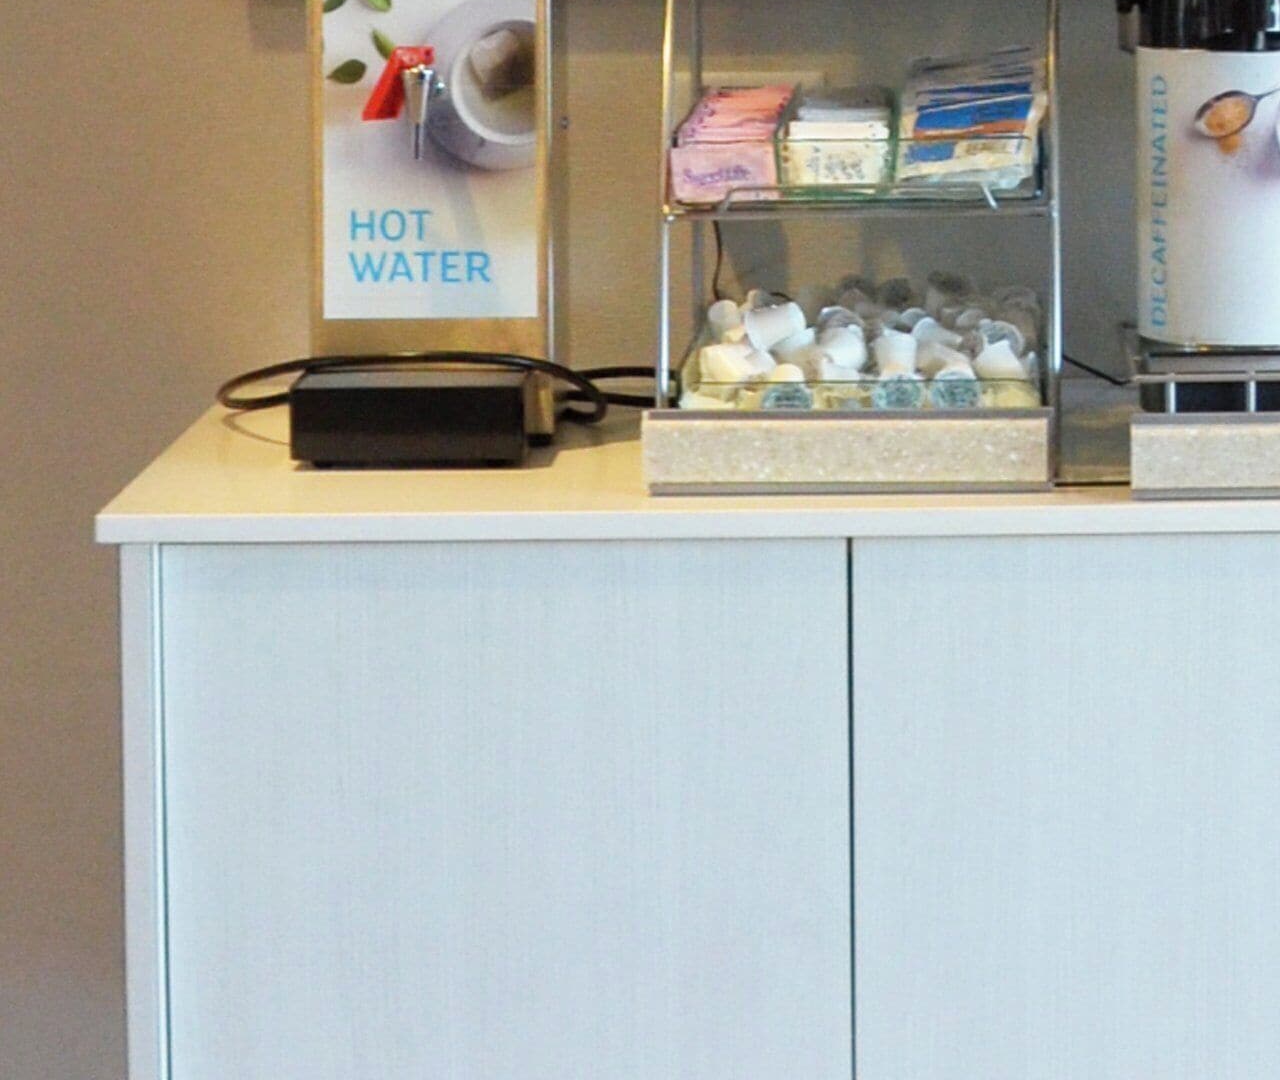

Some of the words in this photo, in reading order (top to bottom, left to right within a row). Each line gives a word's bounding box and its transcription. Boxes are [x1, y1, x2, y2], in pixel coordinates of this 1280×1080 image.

[1151, 74, 1168, 328] DECAFFEINATED
[350, 209, 433, 241] HOT
[348, 250, 492, 283] WATER
